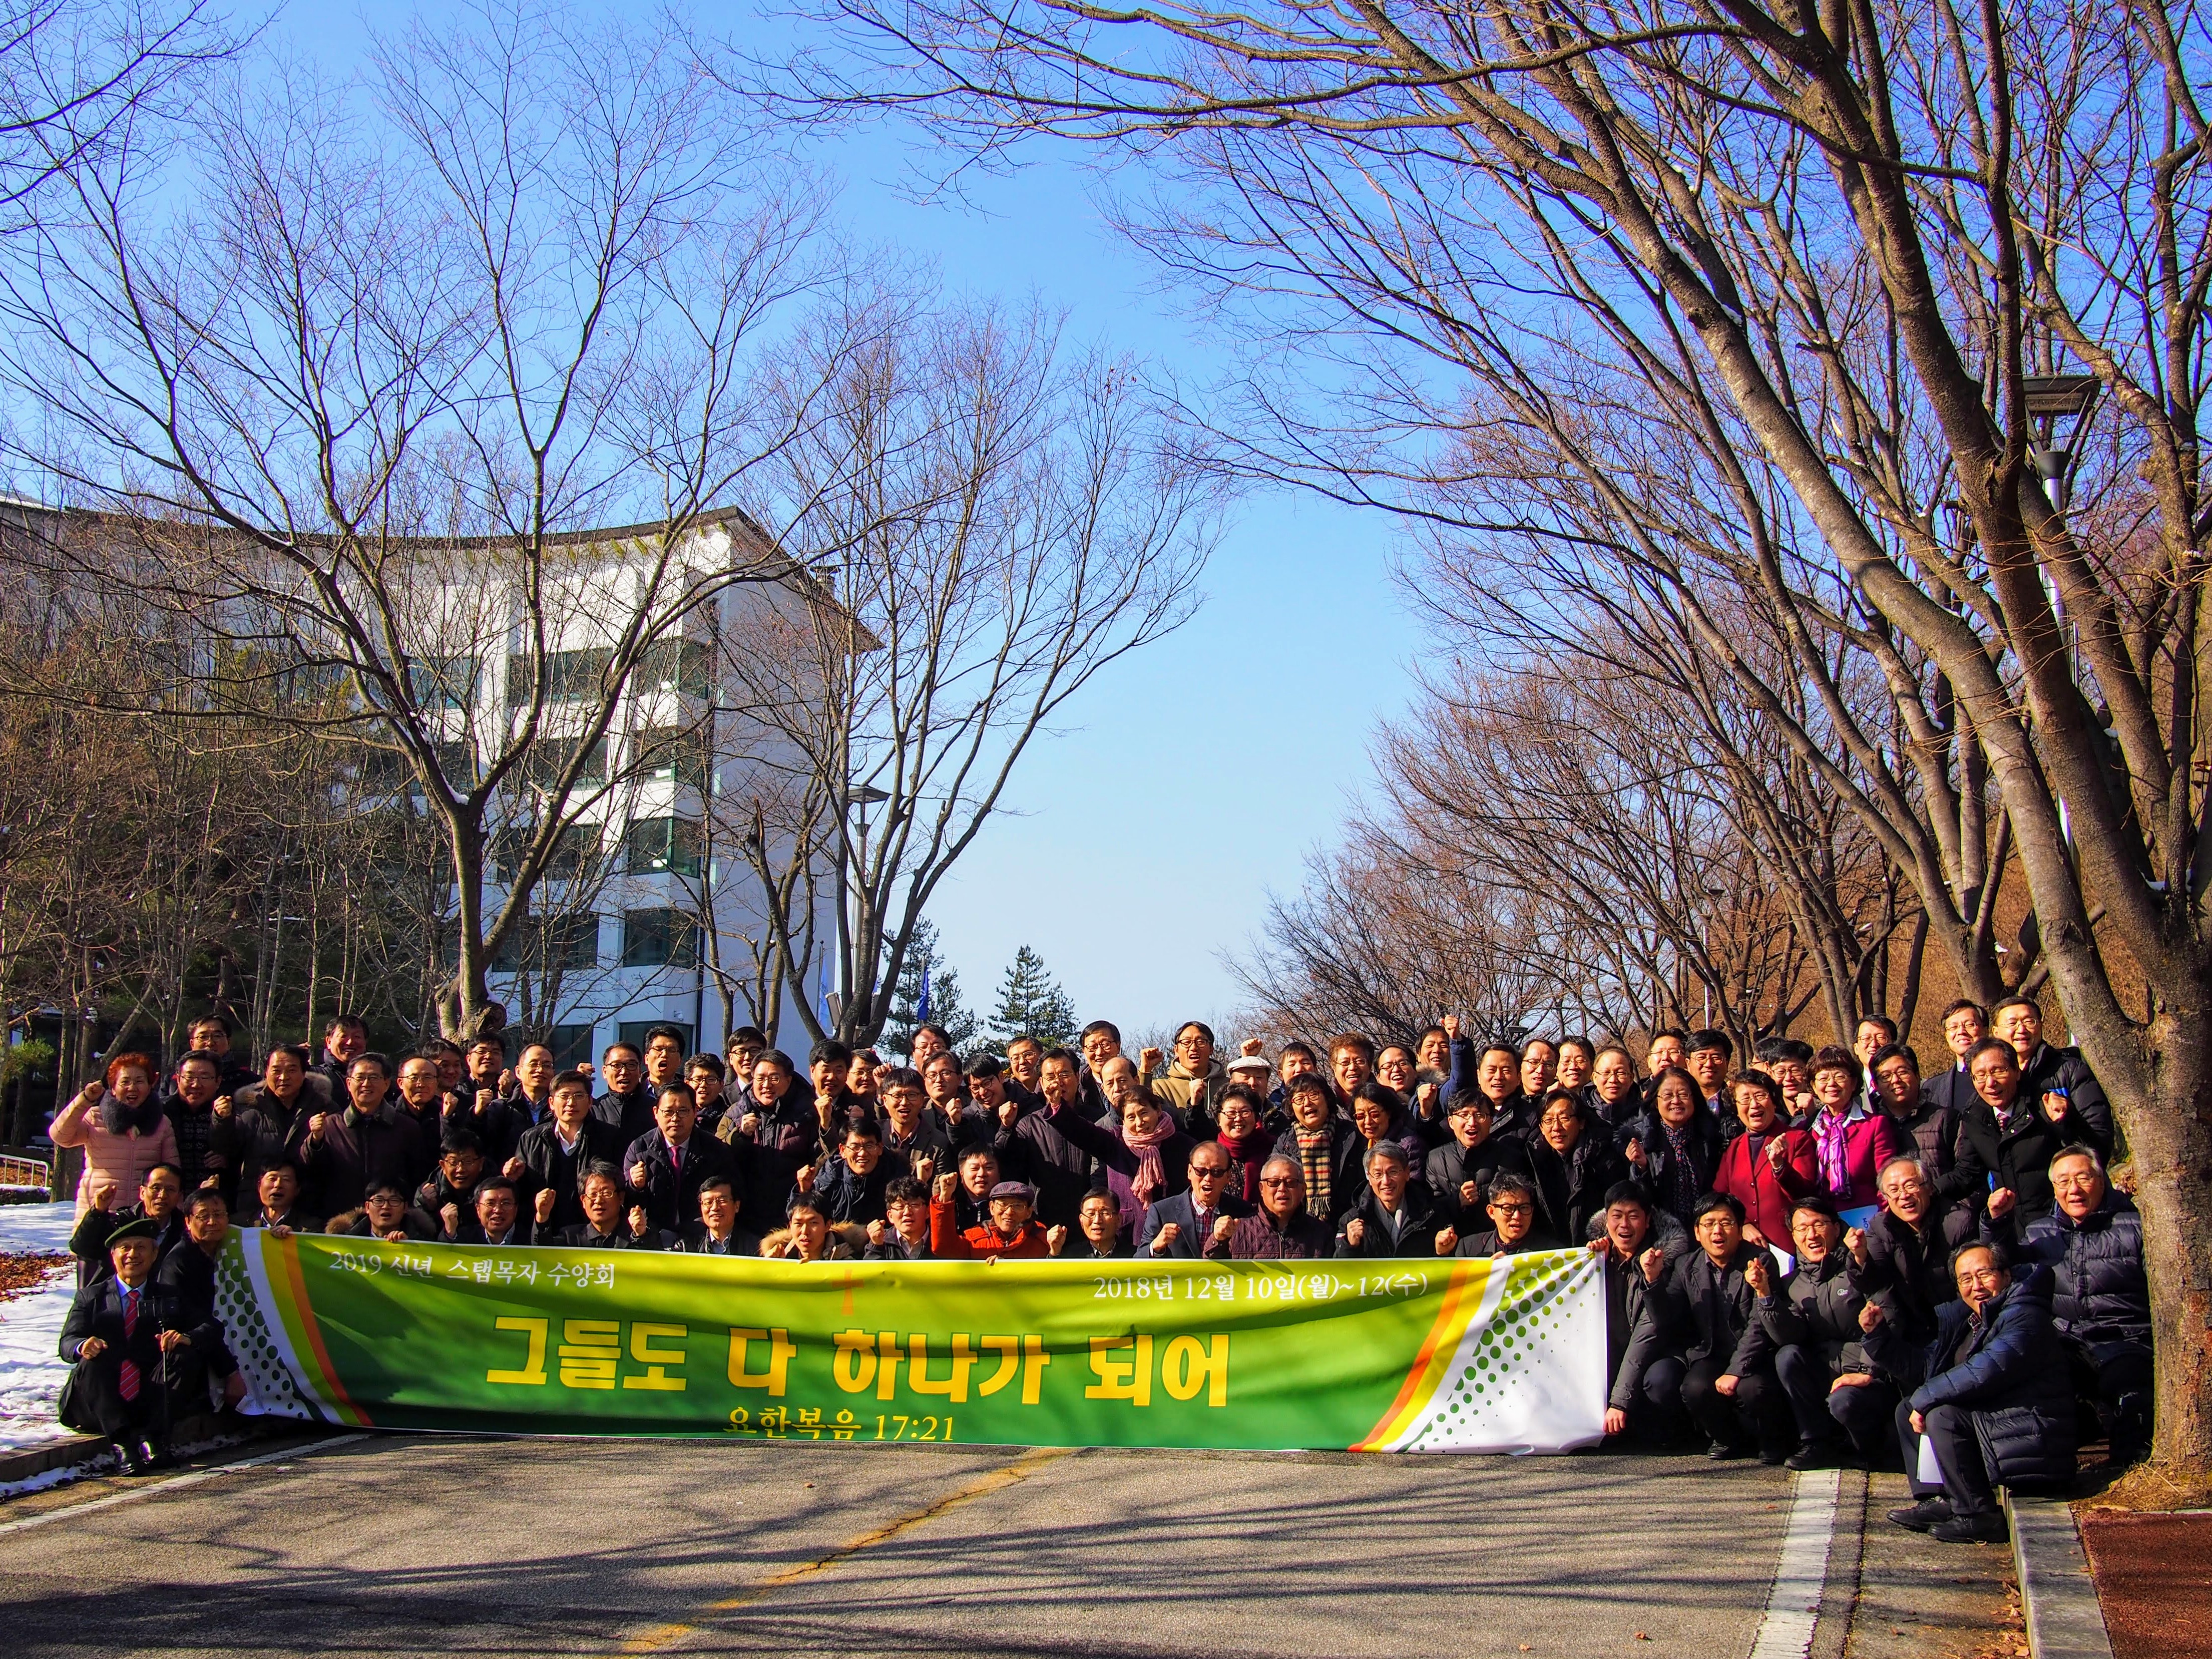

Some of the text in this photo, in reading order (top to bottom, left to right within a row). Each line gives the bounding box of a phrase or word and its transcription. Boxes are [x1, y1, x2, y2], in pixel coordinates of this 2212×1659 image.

[329, 1251, 615, 1289] 2019 신년 스탭목자 수양회
[1093, 1273, 1427, 1301] 2018년 12월 10일(월)~12(수)
[487, 1316, 1229, 1407] 그들도 다 하나가 되어
[723, 1406, 953, 1441] 요한복음 17:21
